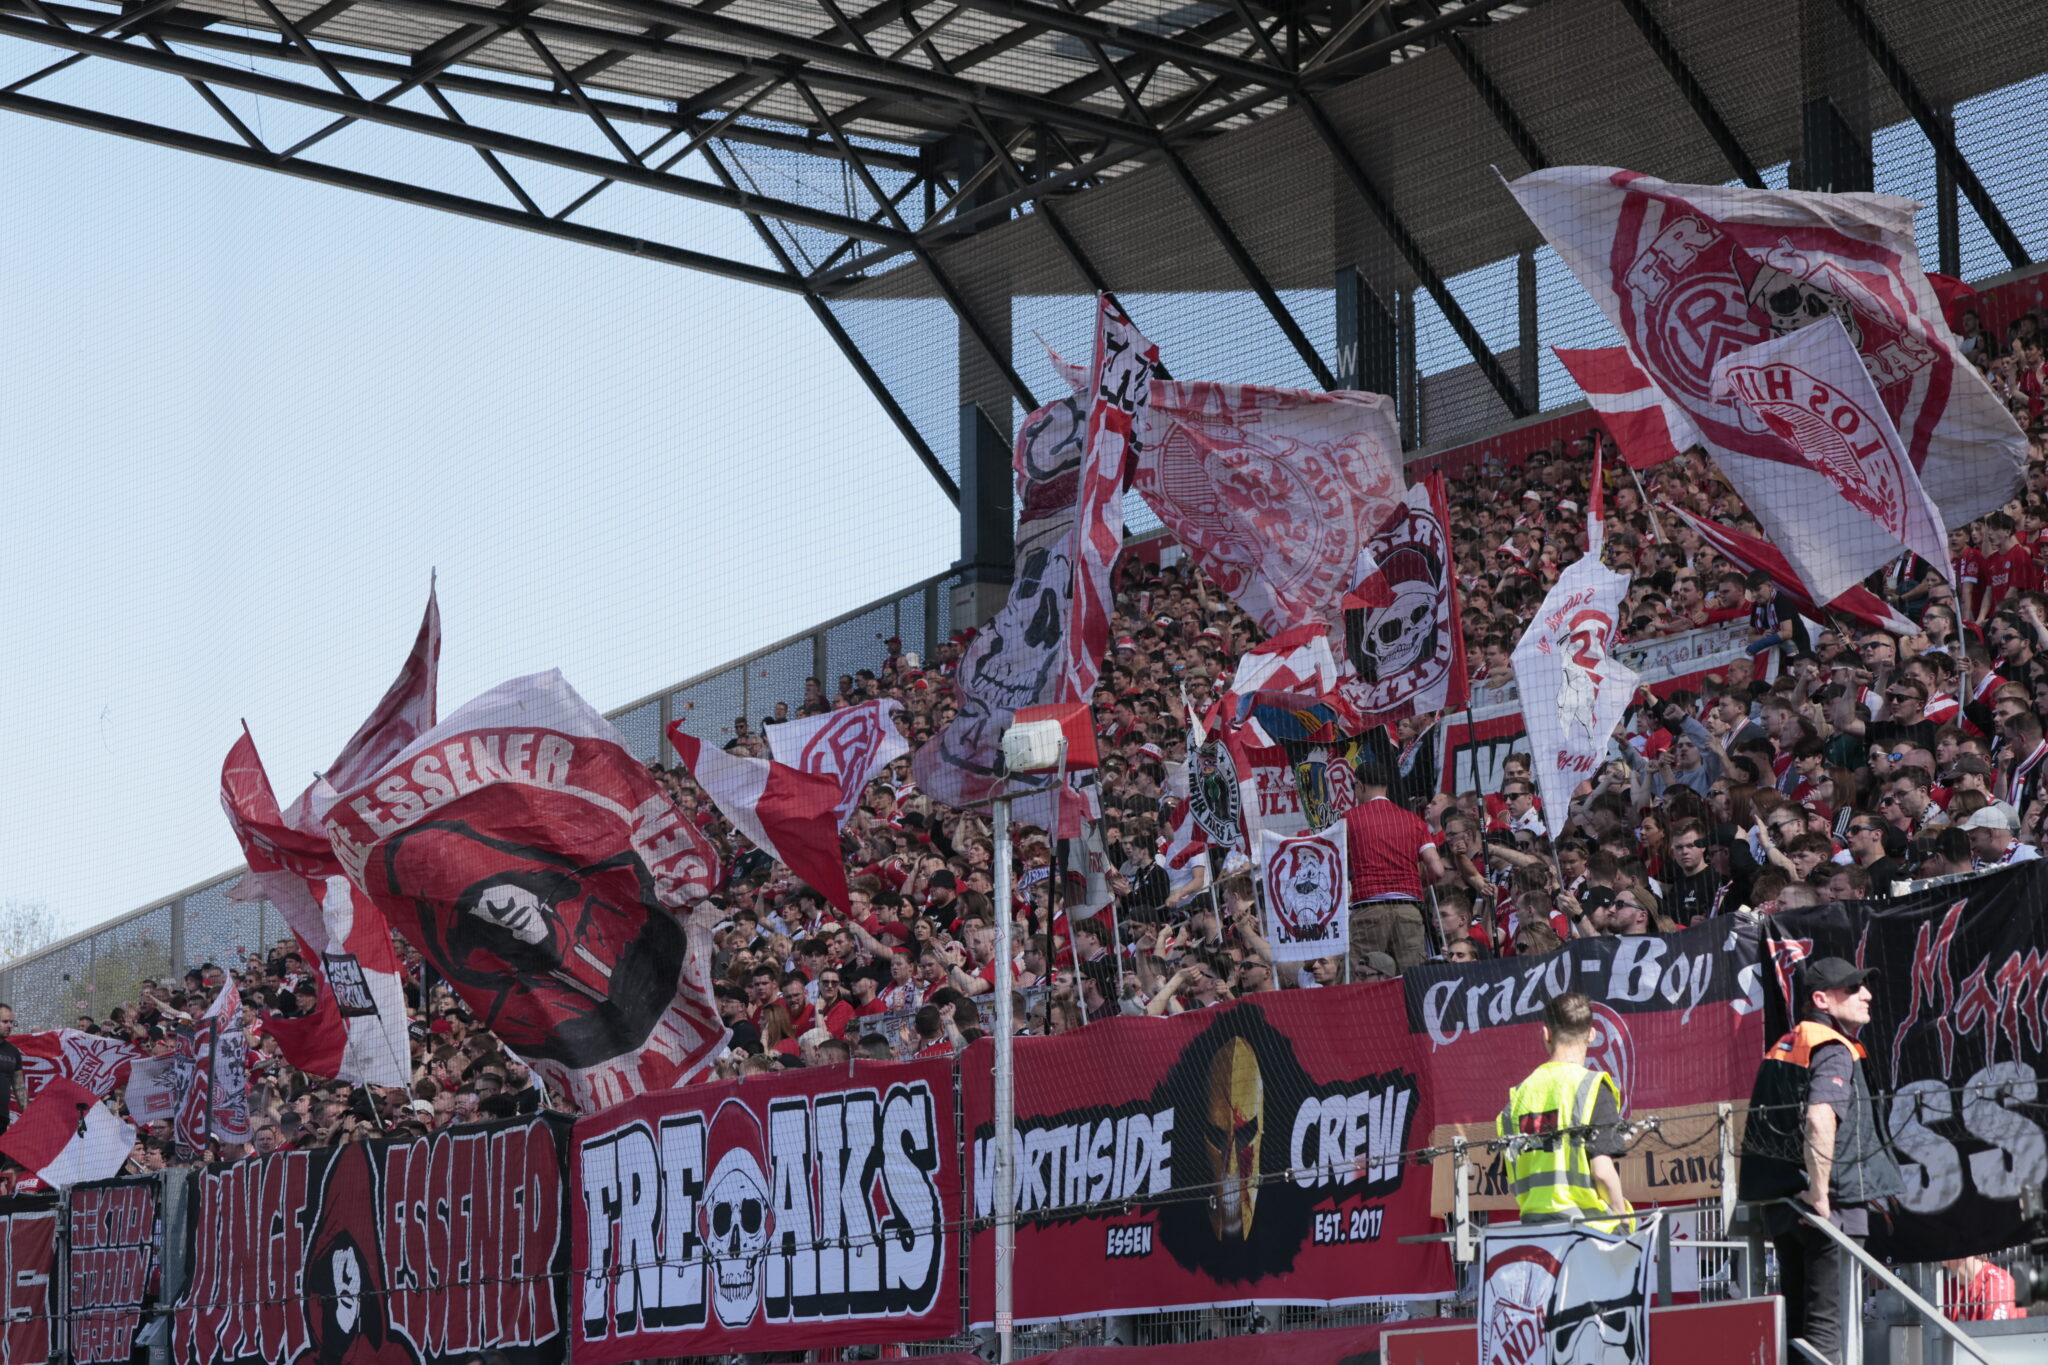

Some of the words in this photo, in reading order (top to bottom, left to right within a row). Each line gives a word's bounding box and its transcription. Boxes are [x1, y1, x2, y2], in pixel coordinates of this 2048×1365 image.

[349, 733, 575, 839] ESSENER
[1290, 1084, 1412, 1189] CREW
[1646, 1150, 1724, 1189] Lang
[172, 1150, 312, 1365] JUNGE
[383, 1117, 563, 1365] ESSENER
[581, 1079, 943, 1341] FREAKS
[1106, 1226, 1152, 1257] ESSEN
[1314, 1212, 1347, 1243] EST.
[1349, 1209, 1384, 1240] 2017
